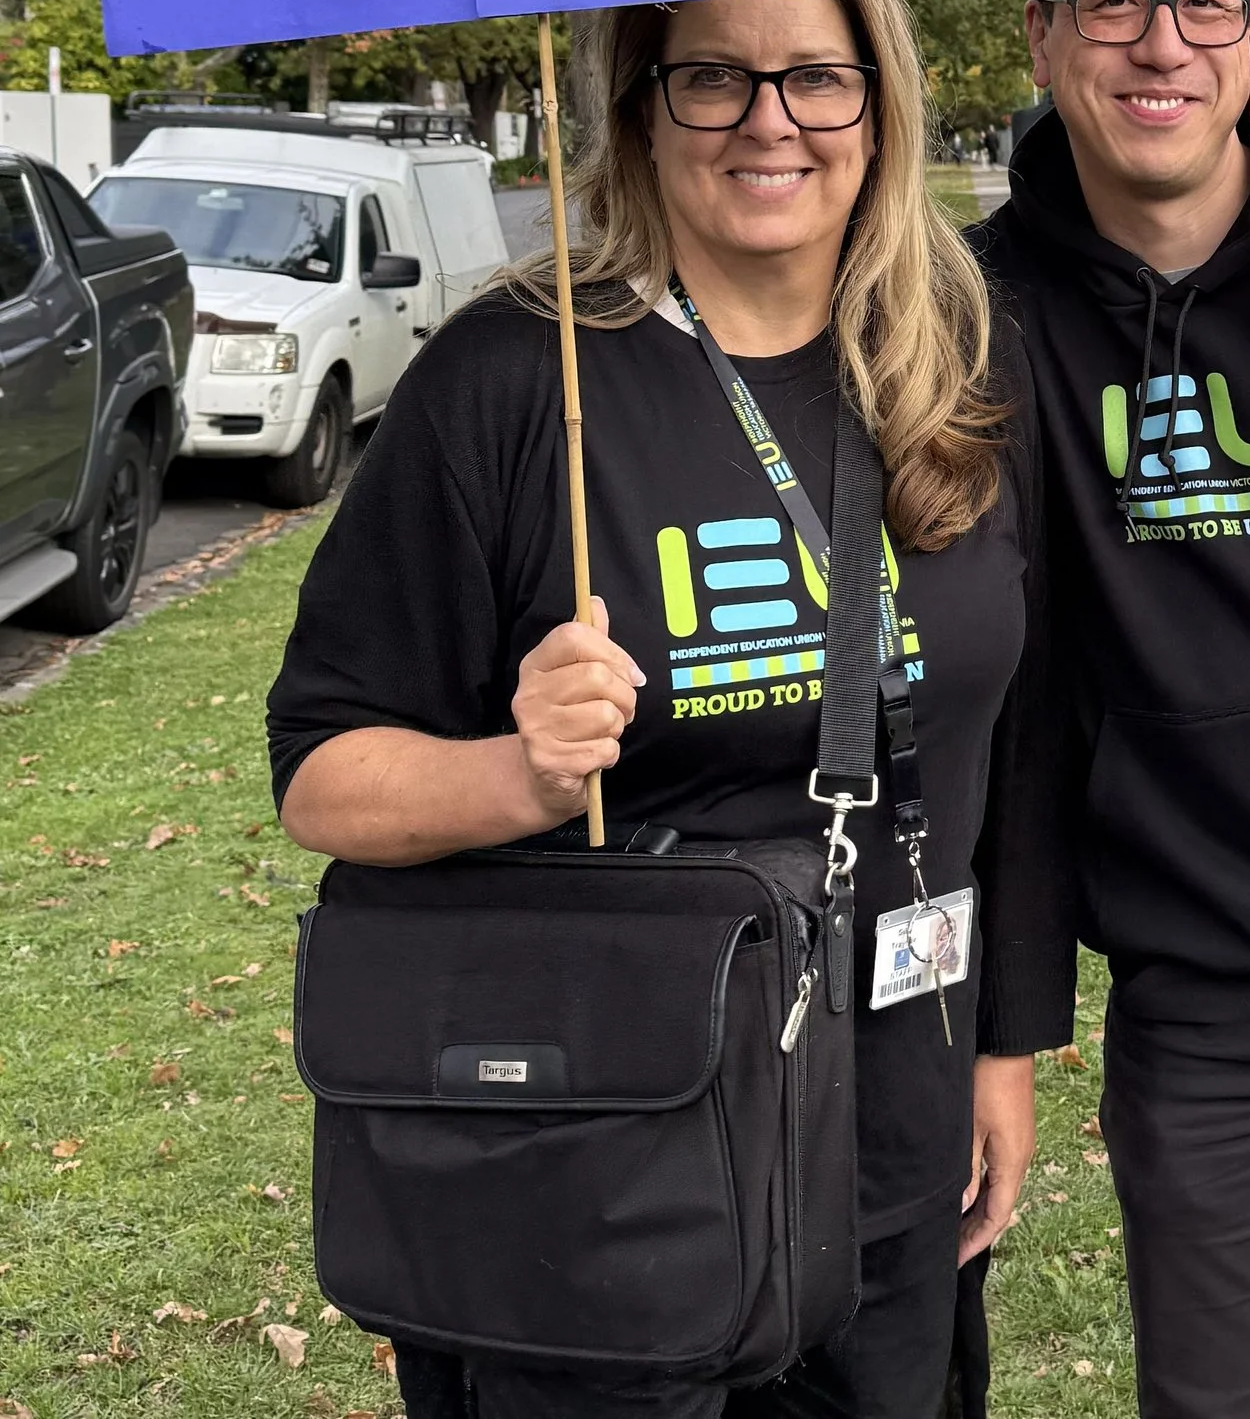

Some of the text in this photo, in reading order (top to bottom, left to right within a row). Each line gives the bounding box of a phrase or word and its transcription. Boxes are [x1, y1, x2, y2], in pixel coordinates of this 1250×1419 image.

[1163, 481, 1208, 493] EDCATION
[1188, 519, 1218, 540] TO
[1220, 519, 1243, 536] BE
[669, 643, 738, 661] INDEPENDENT
[740, 637, 792, 652] EDUCATION
[794, 632, 823, 645] UNION
[672, 679, 824, 719] PROUD TO B
[483, 1065, 521, 1077] Targus
